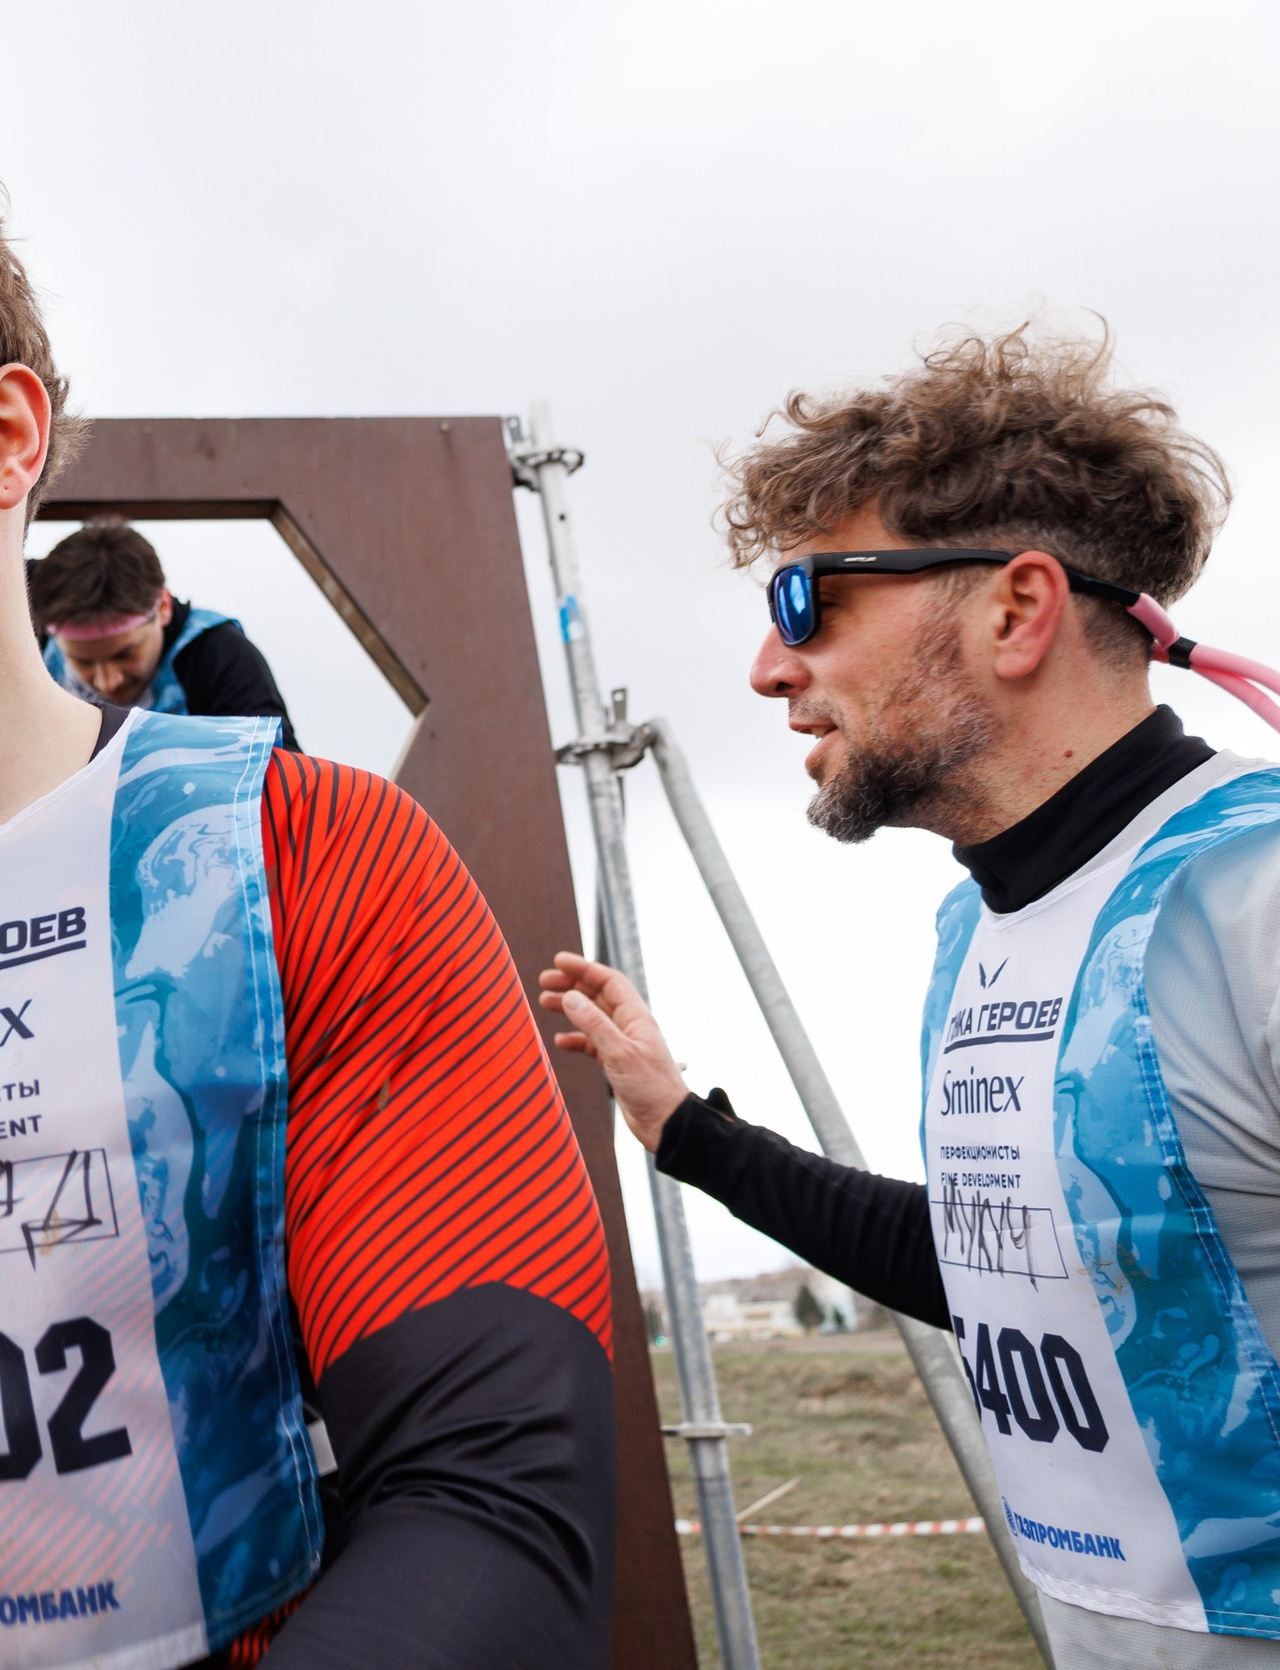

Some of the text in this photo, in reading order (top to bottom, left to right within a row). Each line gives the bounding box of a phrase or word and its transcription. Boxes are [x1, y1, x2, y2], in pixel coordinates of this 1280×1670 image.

[977, 997, 1063, 1032] ГЕРОЕВ
[941, 1066, 1024, 1115] Sminex
[940, 1146, 1020, 1162] ПЕРФЕКЦИОНИСТЫ
[941, 1172, 1021, 1188] FINE DEVELOPMENT
[1014, 1512, 1126, 1561] ГАЗПРОМБАНК
